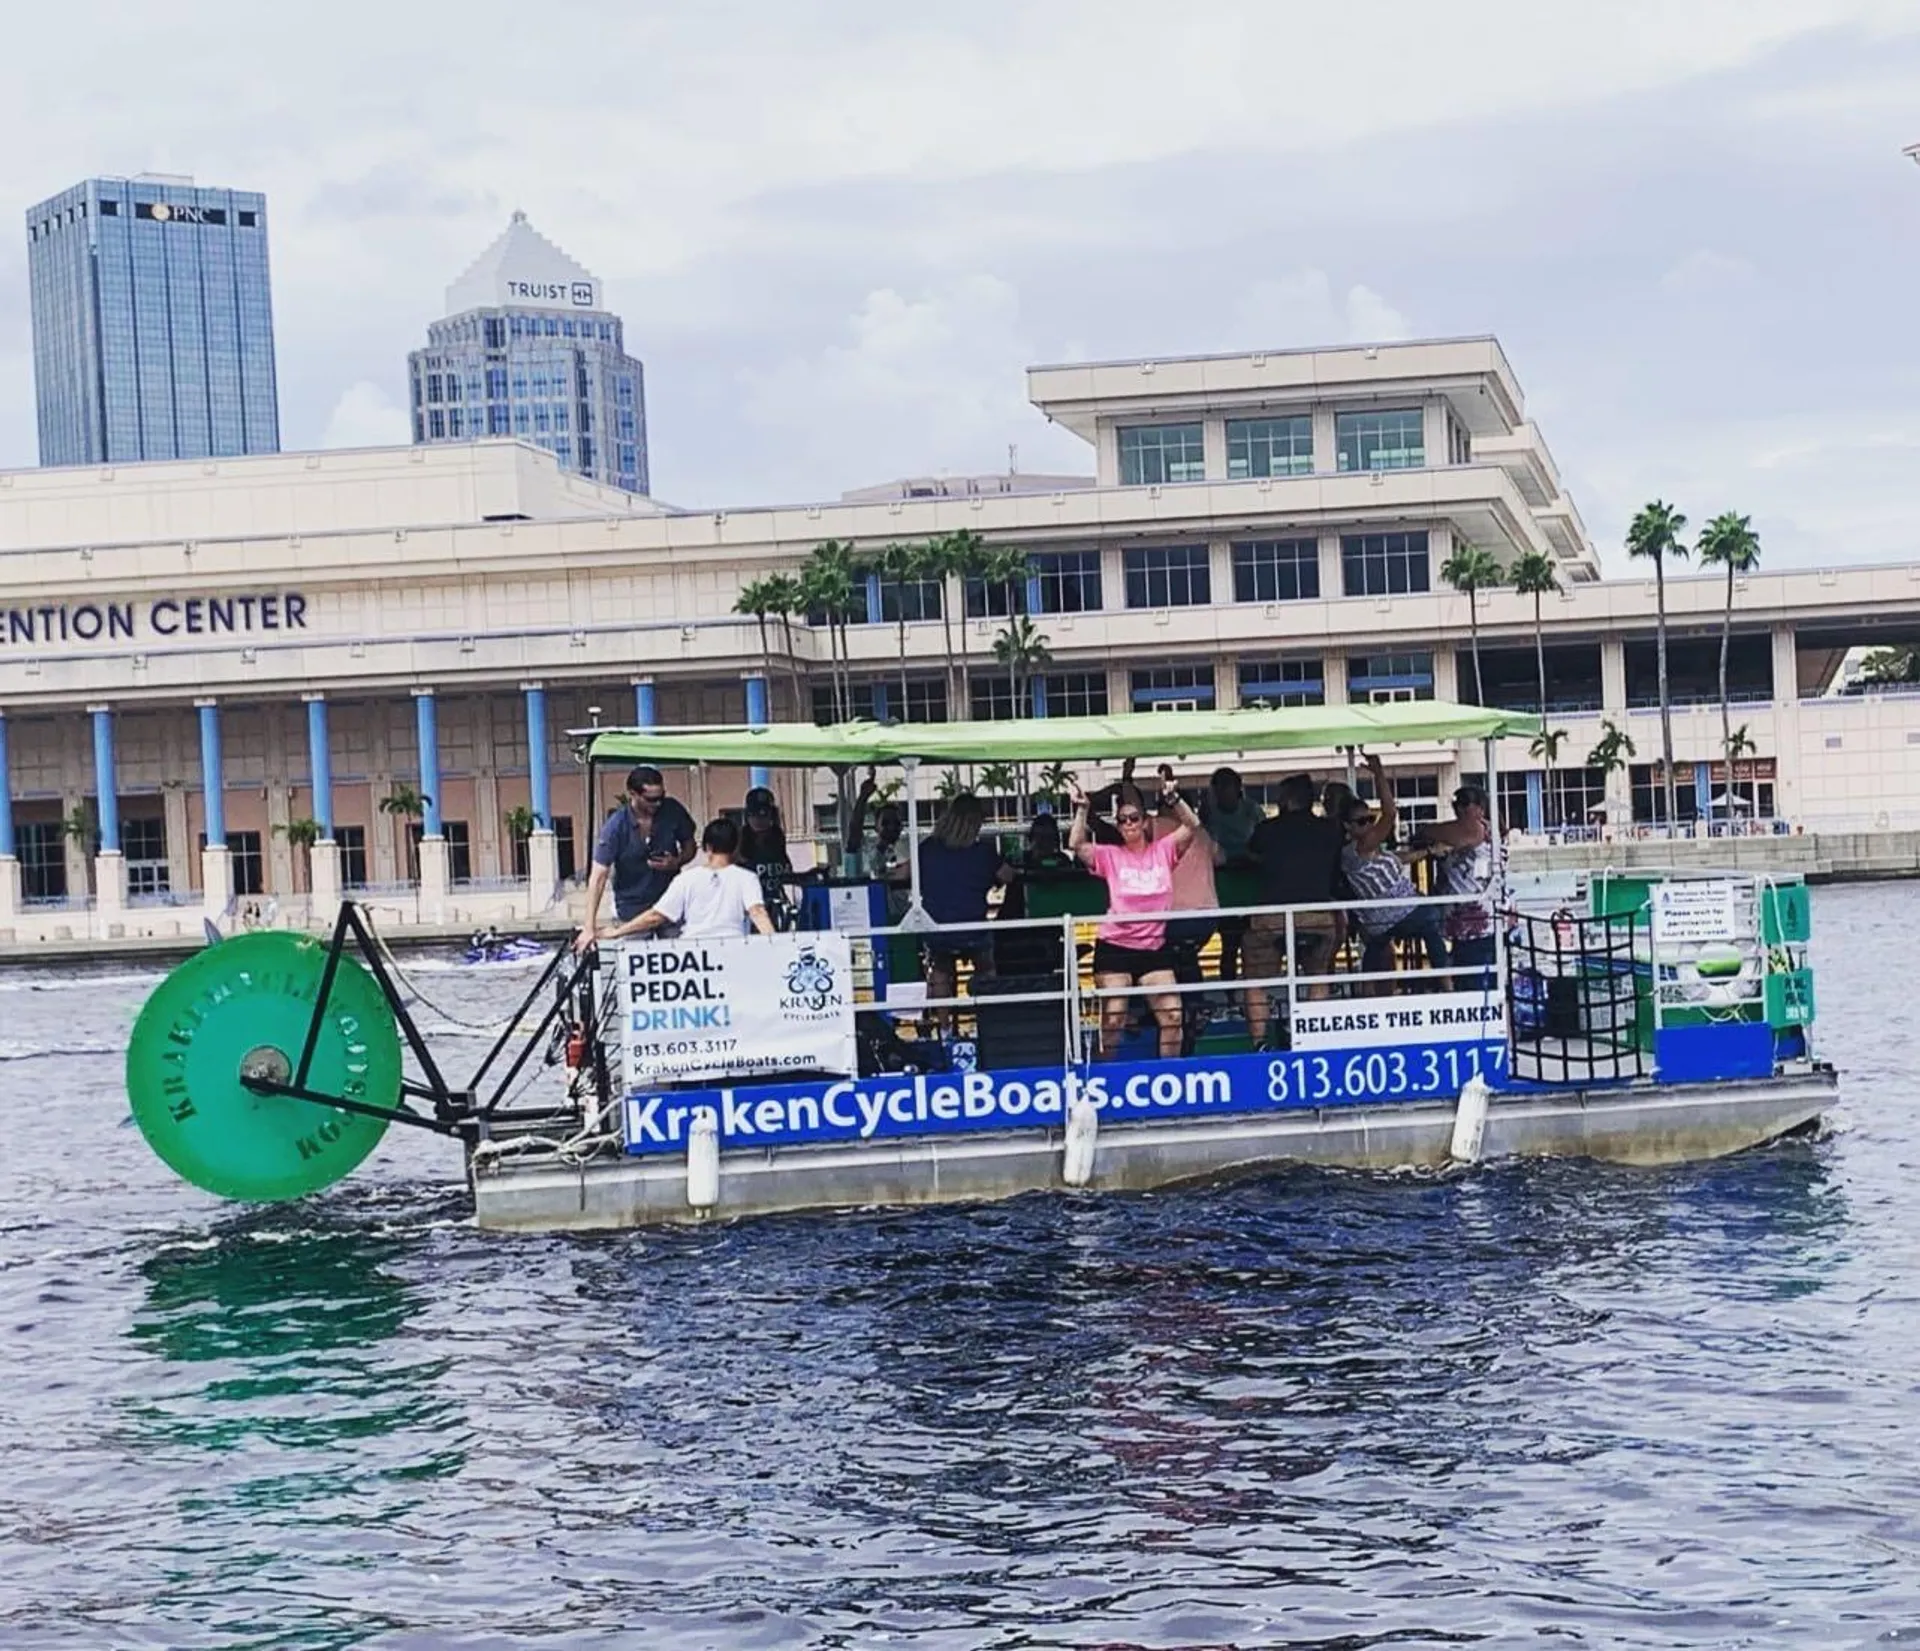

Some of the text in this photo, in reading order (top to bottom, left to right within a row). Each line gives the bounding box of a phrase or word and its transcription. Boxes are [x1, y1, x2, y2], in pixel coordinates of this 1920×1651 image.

[173, 205, 210, 223] PNC
[507, 281, 567, 299] TRUIST
[150, 592, 308, 635] CENTER
[628, 950, 724, 976] PEDAL.
[630, 978, 726, 1003] PEDAL.
[631, 1005, 731, 1032] DRINK!
[1295, 1004, 1503, 1034] RELEASE THE KRAKEN
[633, 1039, 738, 1058] 813.603.3117
[634, 1054, 817, 1075] KrakenCycleBoats.com
[1267, 1046, 1506, 1101] 813.603.3117
[627, 1068, 1232, 1144] KrakenCycleBoats.com
